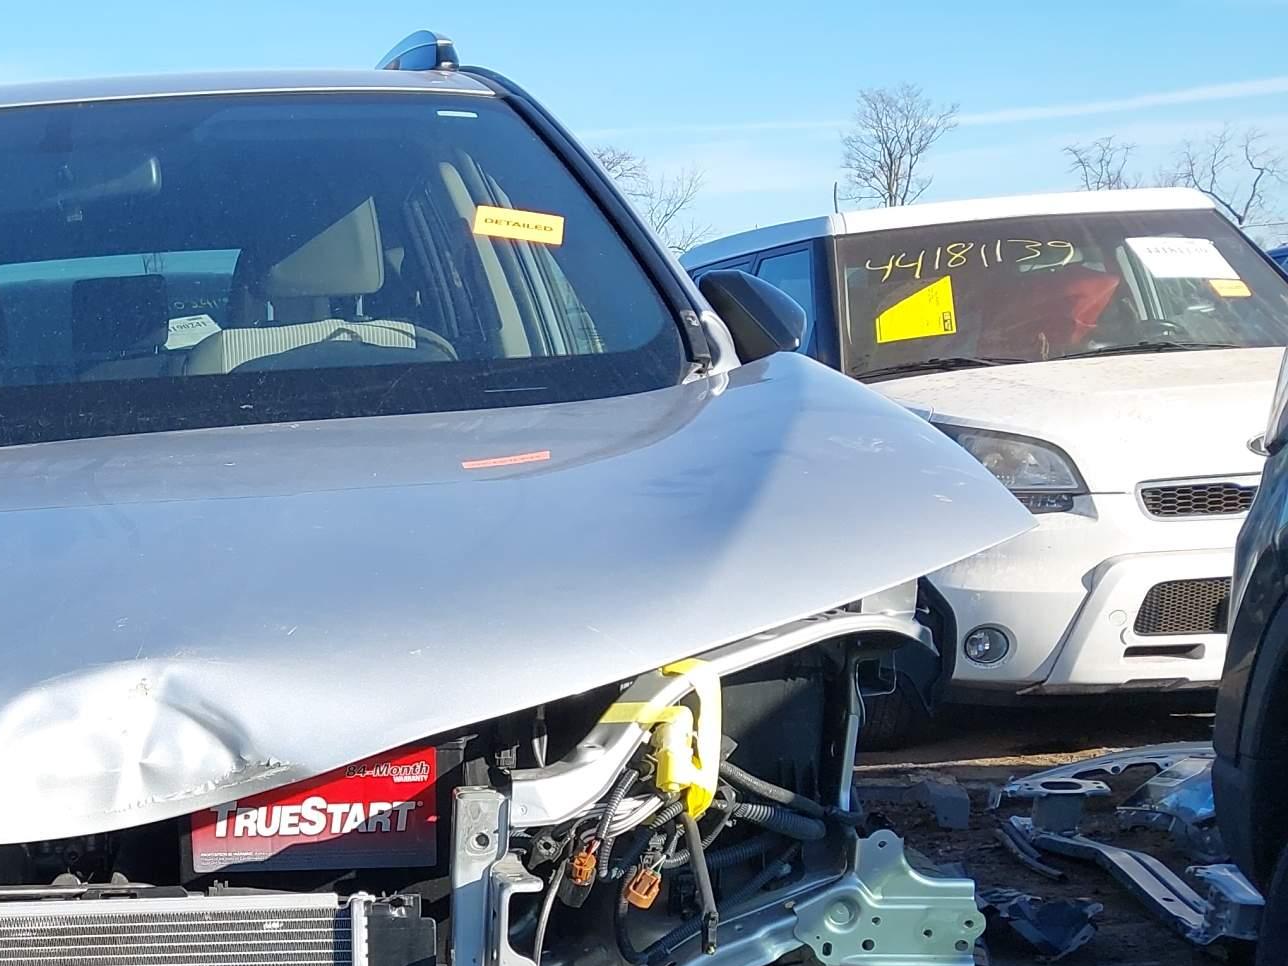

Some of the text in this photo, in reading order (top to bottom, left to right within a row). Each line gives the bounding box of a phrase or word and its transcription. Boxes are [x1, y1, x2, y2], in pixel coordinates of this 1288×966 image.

[484, 217, 554, 232] DETAILED
[864, 239, 1075, 283] 44181139
[345, 761, 430, 778] 84-Month
